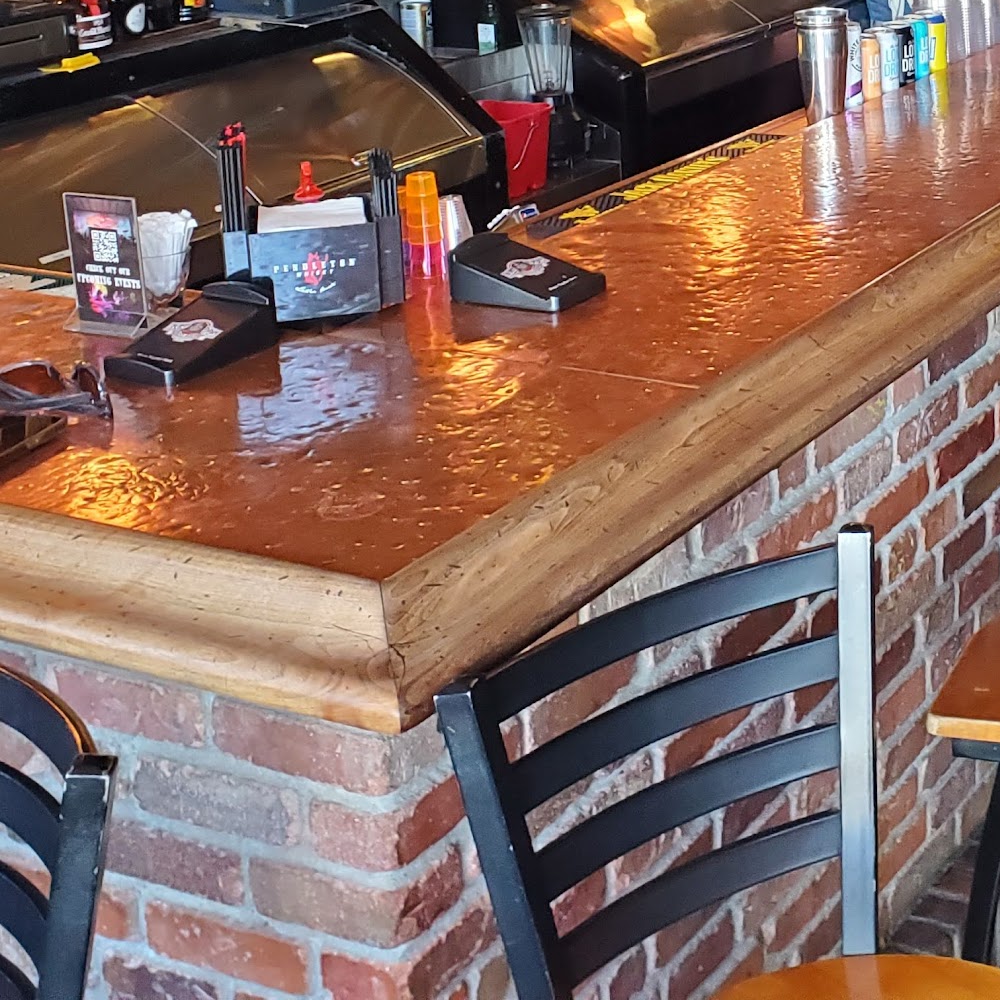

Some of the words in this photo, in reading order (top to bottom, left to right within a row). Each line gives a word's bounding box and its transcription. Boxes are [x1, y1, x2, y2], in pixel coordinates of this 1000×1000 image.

[105, 265, 117, 275] OUT
[119, 267, 130, 276] OUR
[273, 258, 356, 274] PENDLETON
[76, 272, 112, 286] UPCOMING
[114, 277, 141, 289] EVENTS
